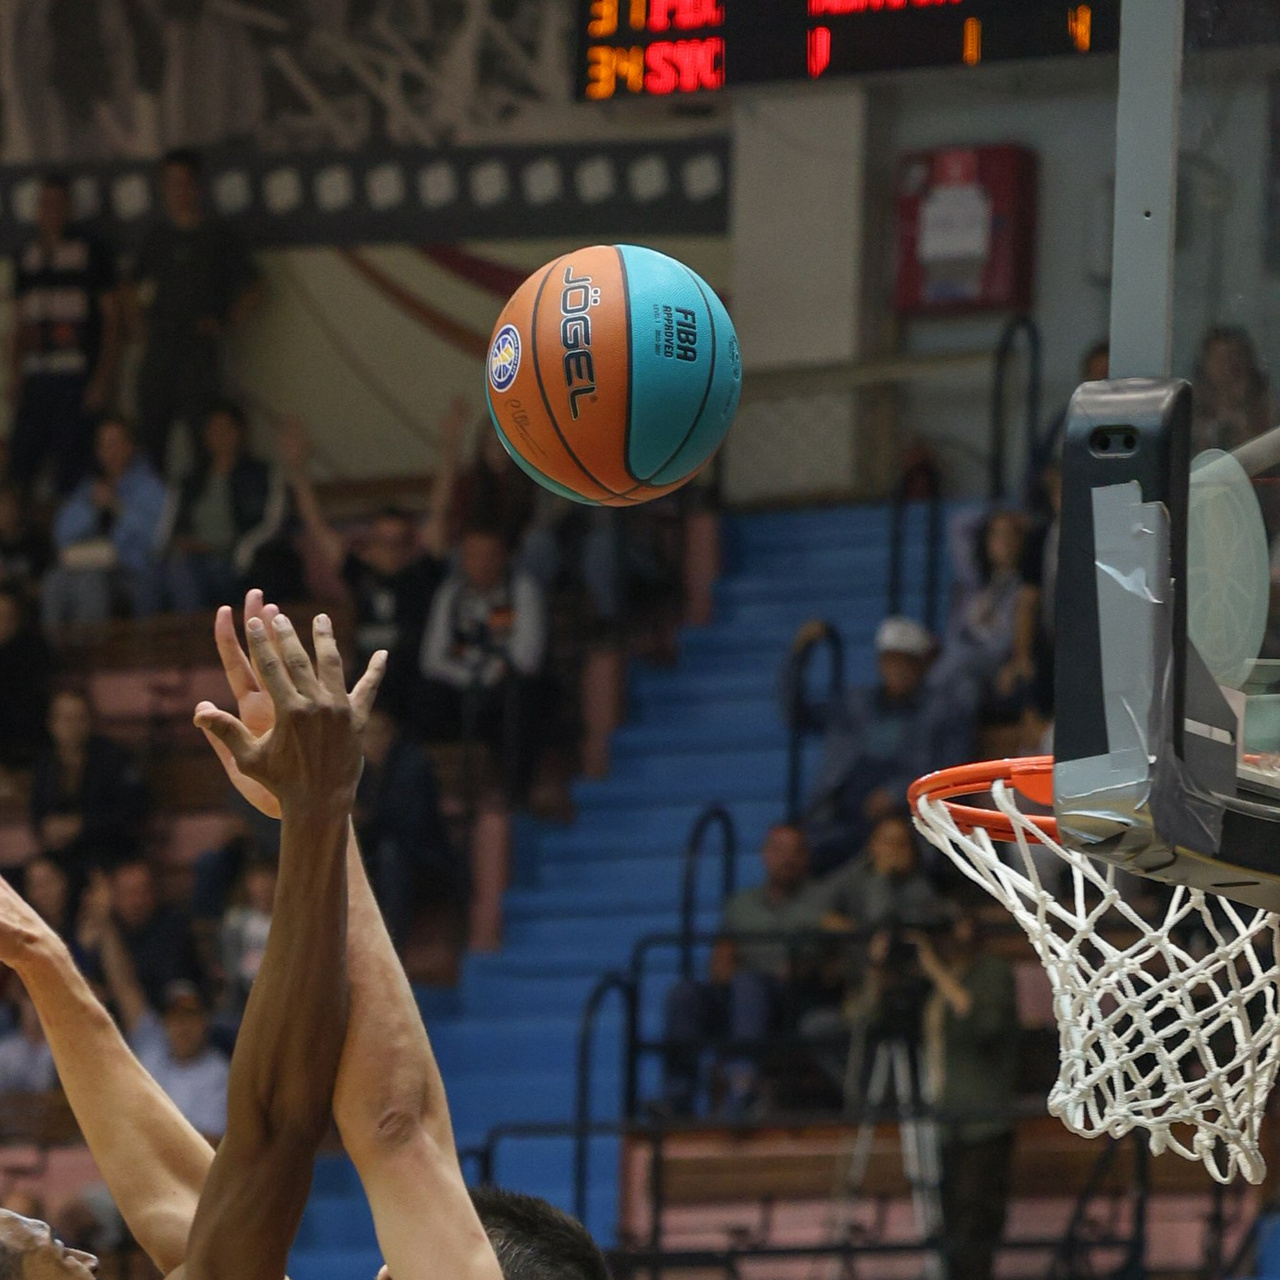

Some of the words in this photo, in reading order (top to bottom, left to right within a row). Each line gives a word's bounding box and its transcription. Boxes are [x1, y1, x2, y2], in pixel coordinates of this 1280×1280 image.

[561, 266, 601, 421] JÖGEL
[662, 304, 674, 358] APPROVED
[675, 306, 697, 362] FIBA
